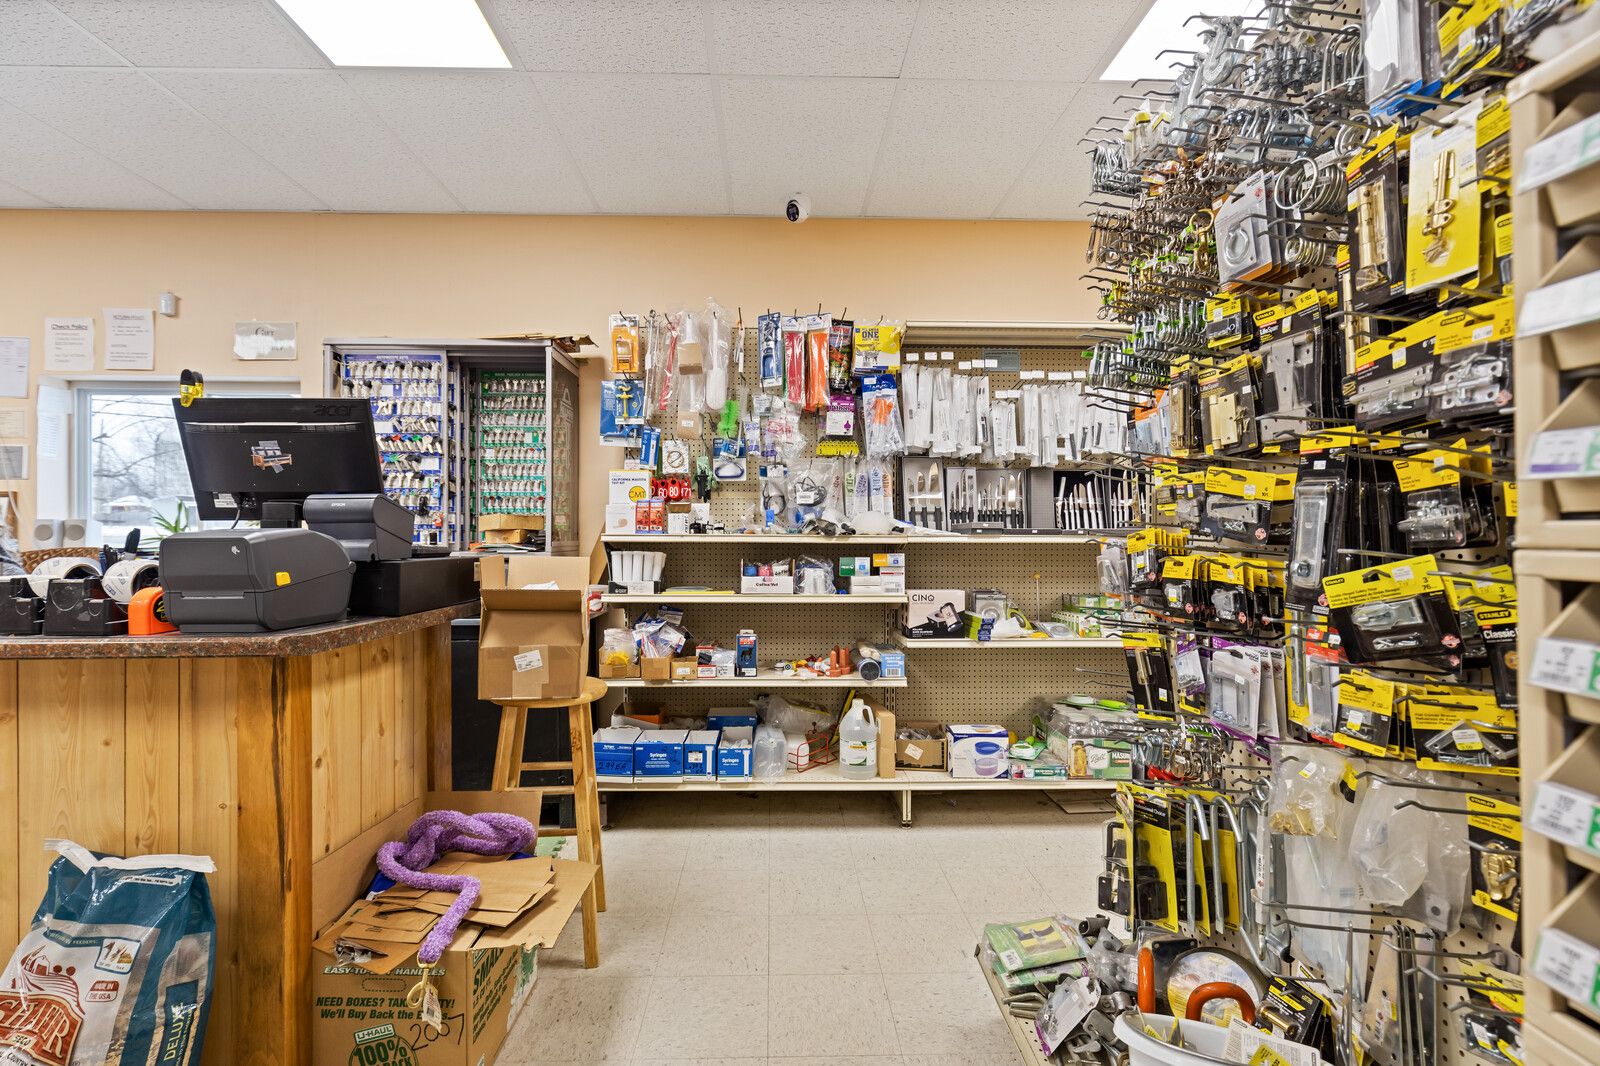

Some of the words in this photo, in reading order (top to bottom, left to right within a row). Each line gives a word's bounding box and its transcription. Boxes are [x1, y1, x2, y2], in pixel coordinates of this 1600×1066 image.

[669, 486, 679, 497] 80
[912, 594, 935, 602] CINQ
[1478, 610, 1511, 620] STANLEY
[1484, 629, 1516, 639] Classic
[316, 997, 343, 1007] NEED
[346, 997, 385, 1008] BOXES?
[320, 1009, 345, 1019] We'll
[348, 1009, 367, 1020] Buy
[369, 1009, 394, 1019] Back
[397, 1009, 414, 1020] the
[356, 1025, 393, 1040] U-HAUL
